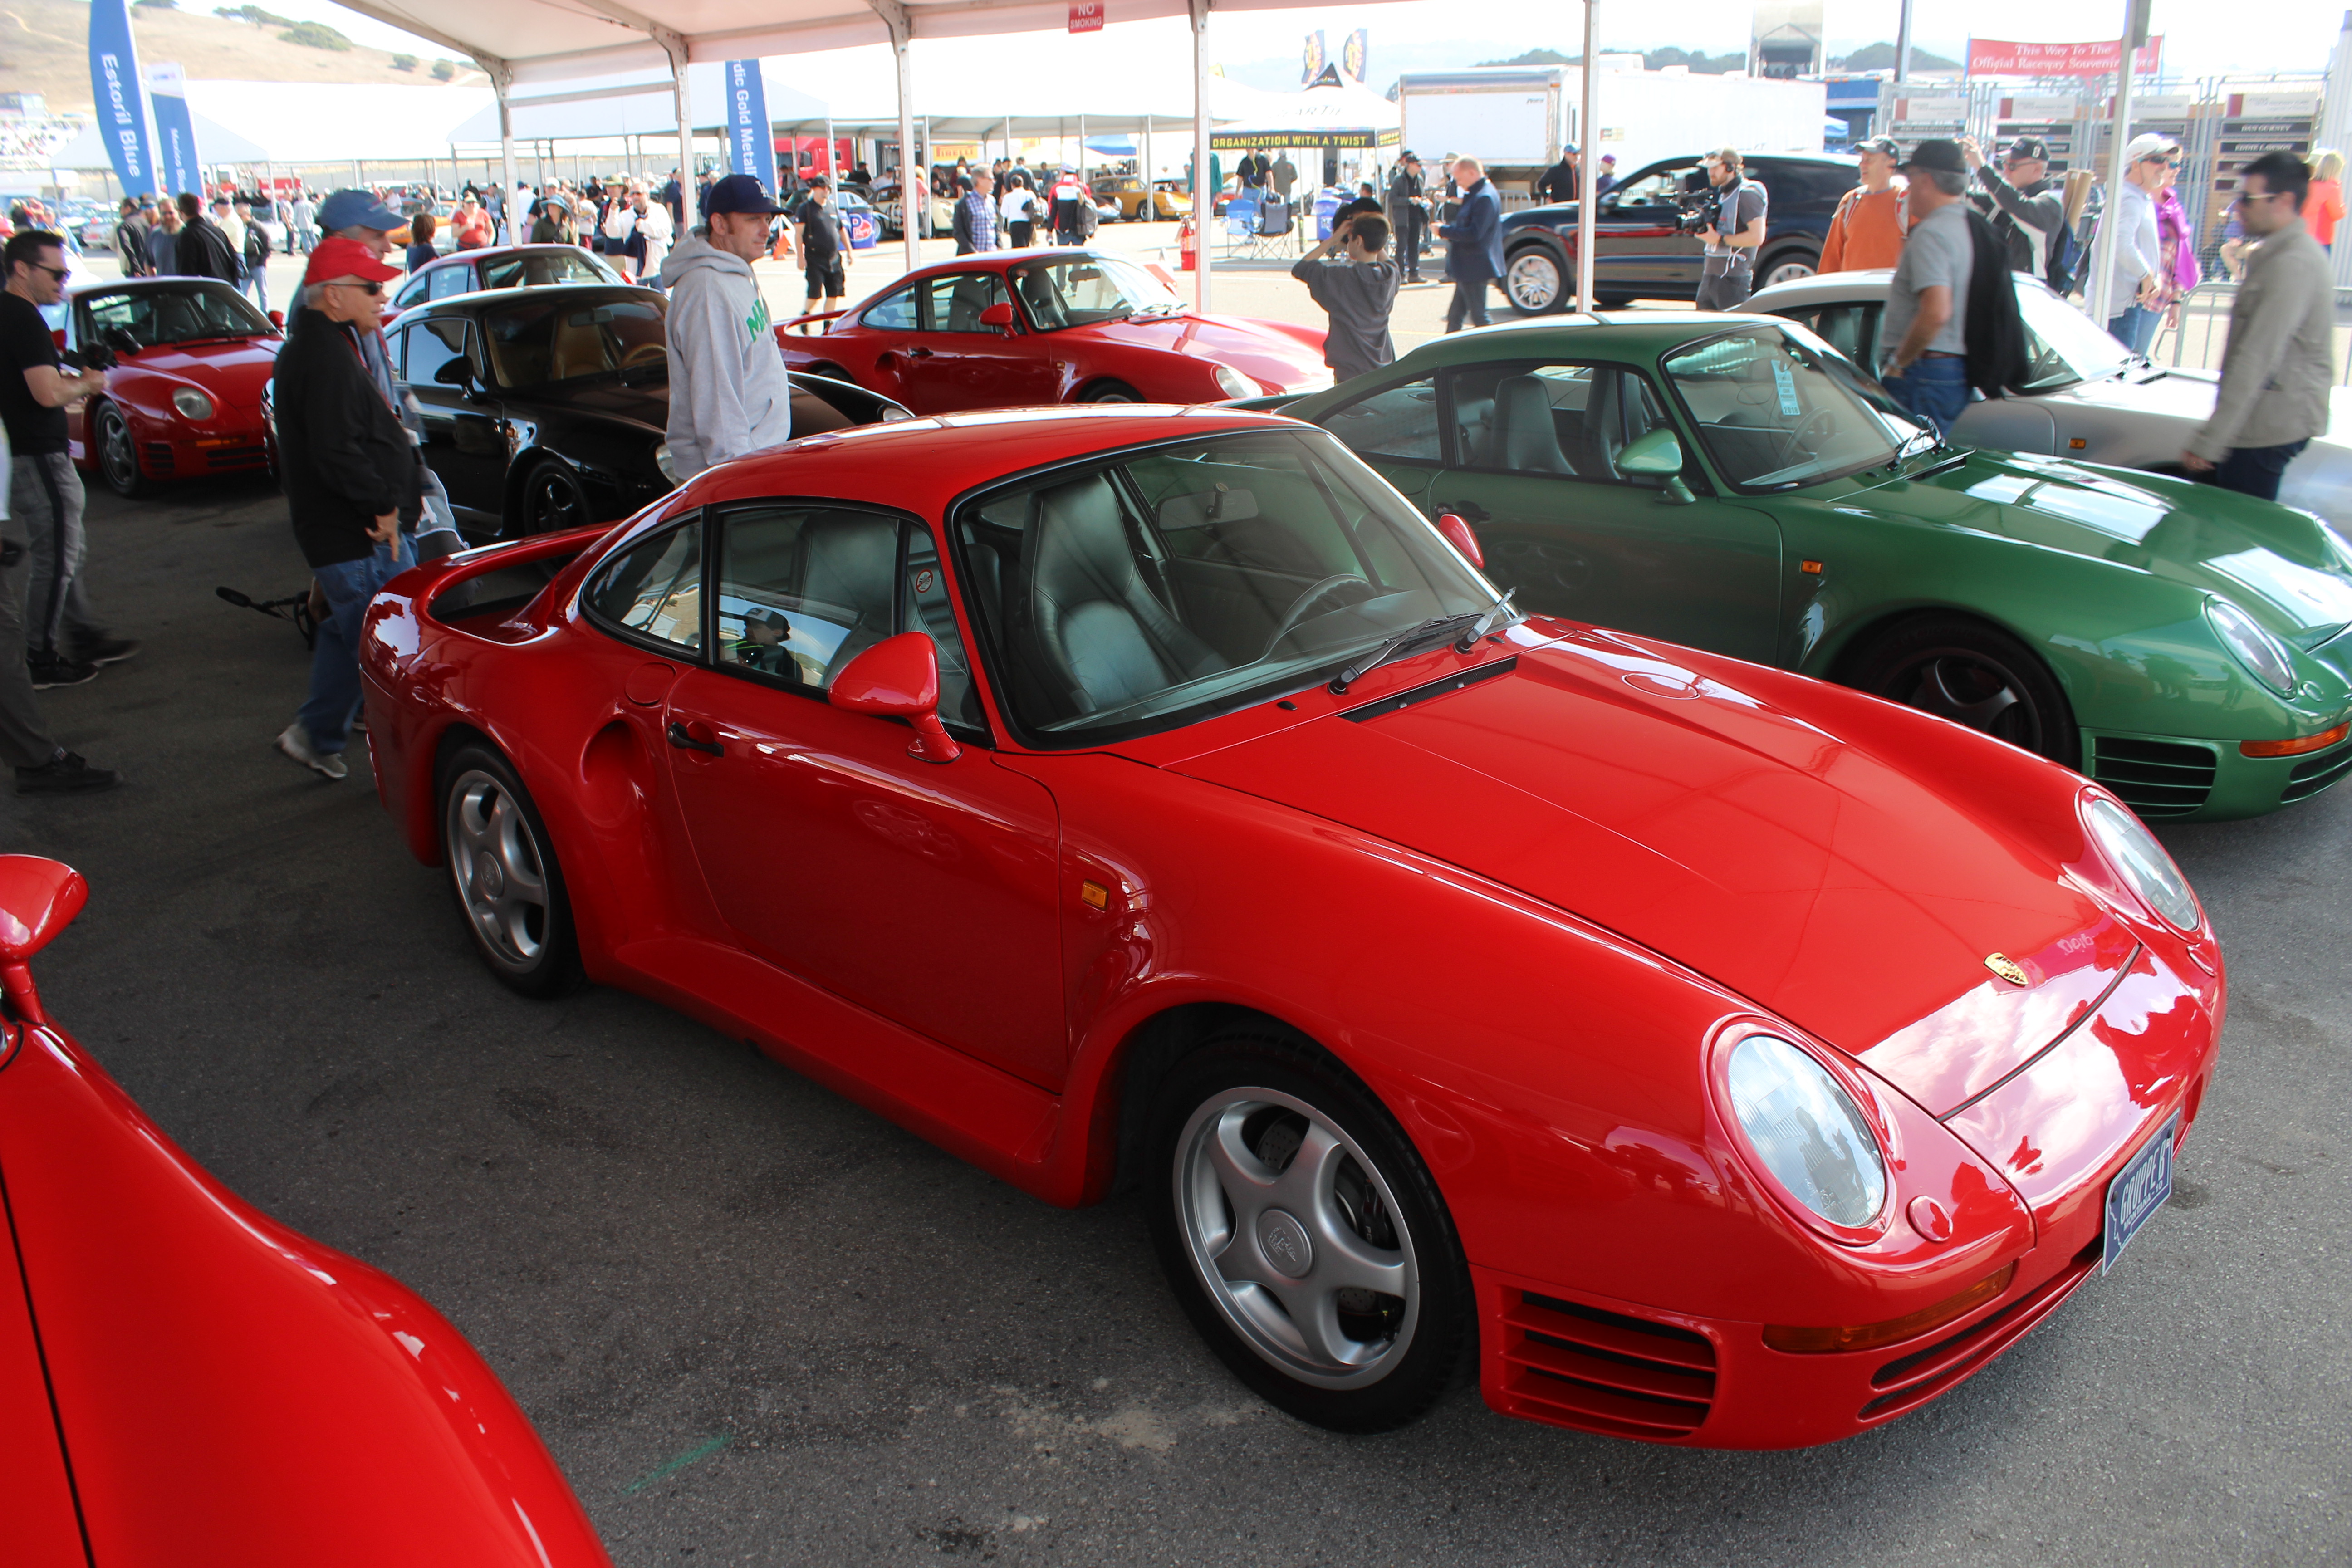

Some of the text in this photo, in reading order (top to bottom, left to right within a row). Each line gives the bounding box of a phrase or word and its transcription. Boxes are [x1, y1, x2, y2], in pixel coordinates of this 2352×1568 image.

[1078, 3, 1094, 16] NO
[1070, 16, 1102, 29] SMOKING
[2015, 44, 2111, 58] This Way To The
[1972, 57, 2014, 69] Official
[2018, 58, 2065, 71] Raceway
[2068, 57, 2119, 69] Souvenir
[736, 89, 752, 125] Gold
[101, 53, 141, 178] Estoril Blue
[1212, 135, 1289, 148] ORGANIZATION
[1292, 135, 1319, 146] WITH
[1322, 135, 1329, 146] A
[1333, 136, 1367, 146] TWIST
[740, 128, 757, 177] Metall
[936, 145, 974, 157] PIRELLI
[2120, 1138, 2166, 1225] GRUPPE B
[2123, 1195, 2151, 1231] MONTANA
[2155, 1180, 2163, 1191] 10
